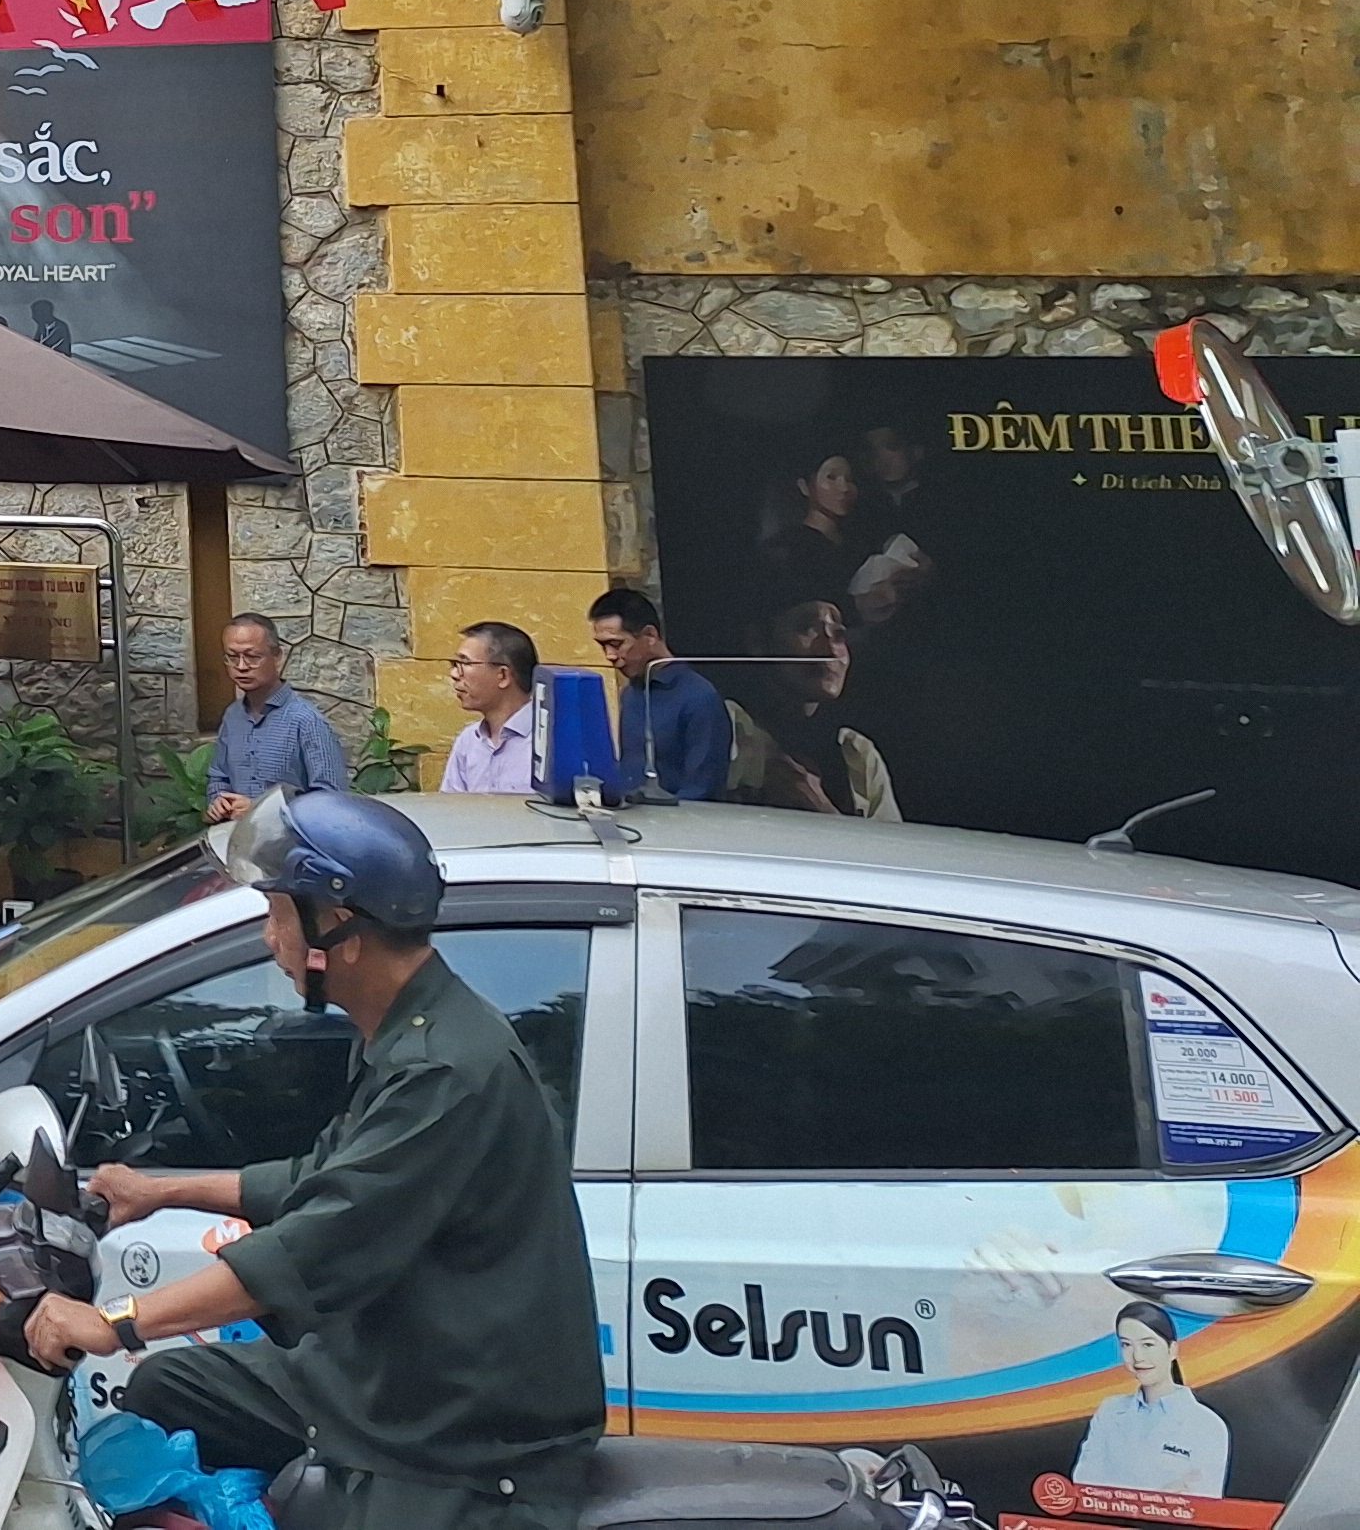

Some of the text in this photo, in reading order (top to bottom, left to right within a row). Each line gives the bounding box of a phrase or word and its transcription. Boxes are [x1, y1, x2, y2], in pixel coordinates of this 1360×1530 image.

[947, 400, 1218, 454] ĐÊM THIÊ
[1101, 473, 1124, 490] Di
[1211, 1071, 1256, 1085] 14.000
[1214, 1089, 1259, 1103] 11.500
[1082, 1496, 1107, 1512] Dịu
[1112, 1498, 1138, 1516] nhẹ
[1142, 1503, 1171, 1517] cho
